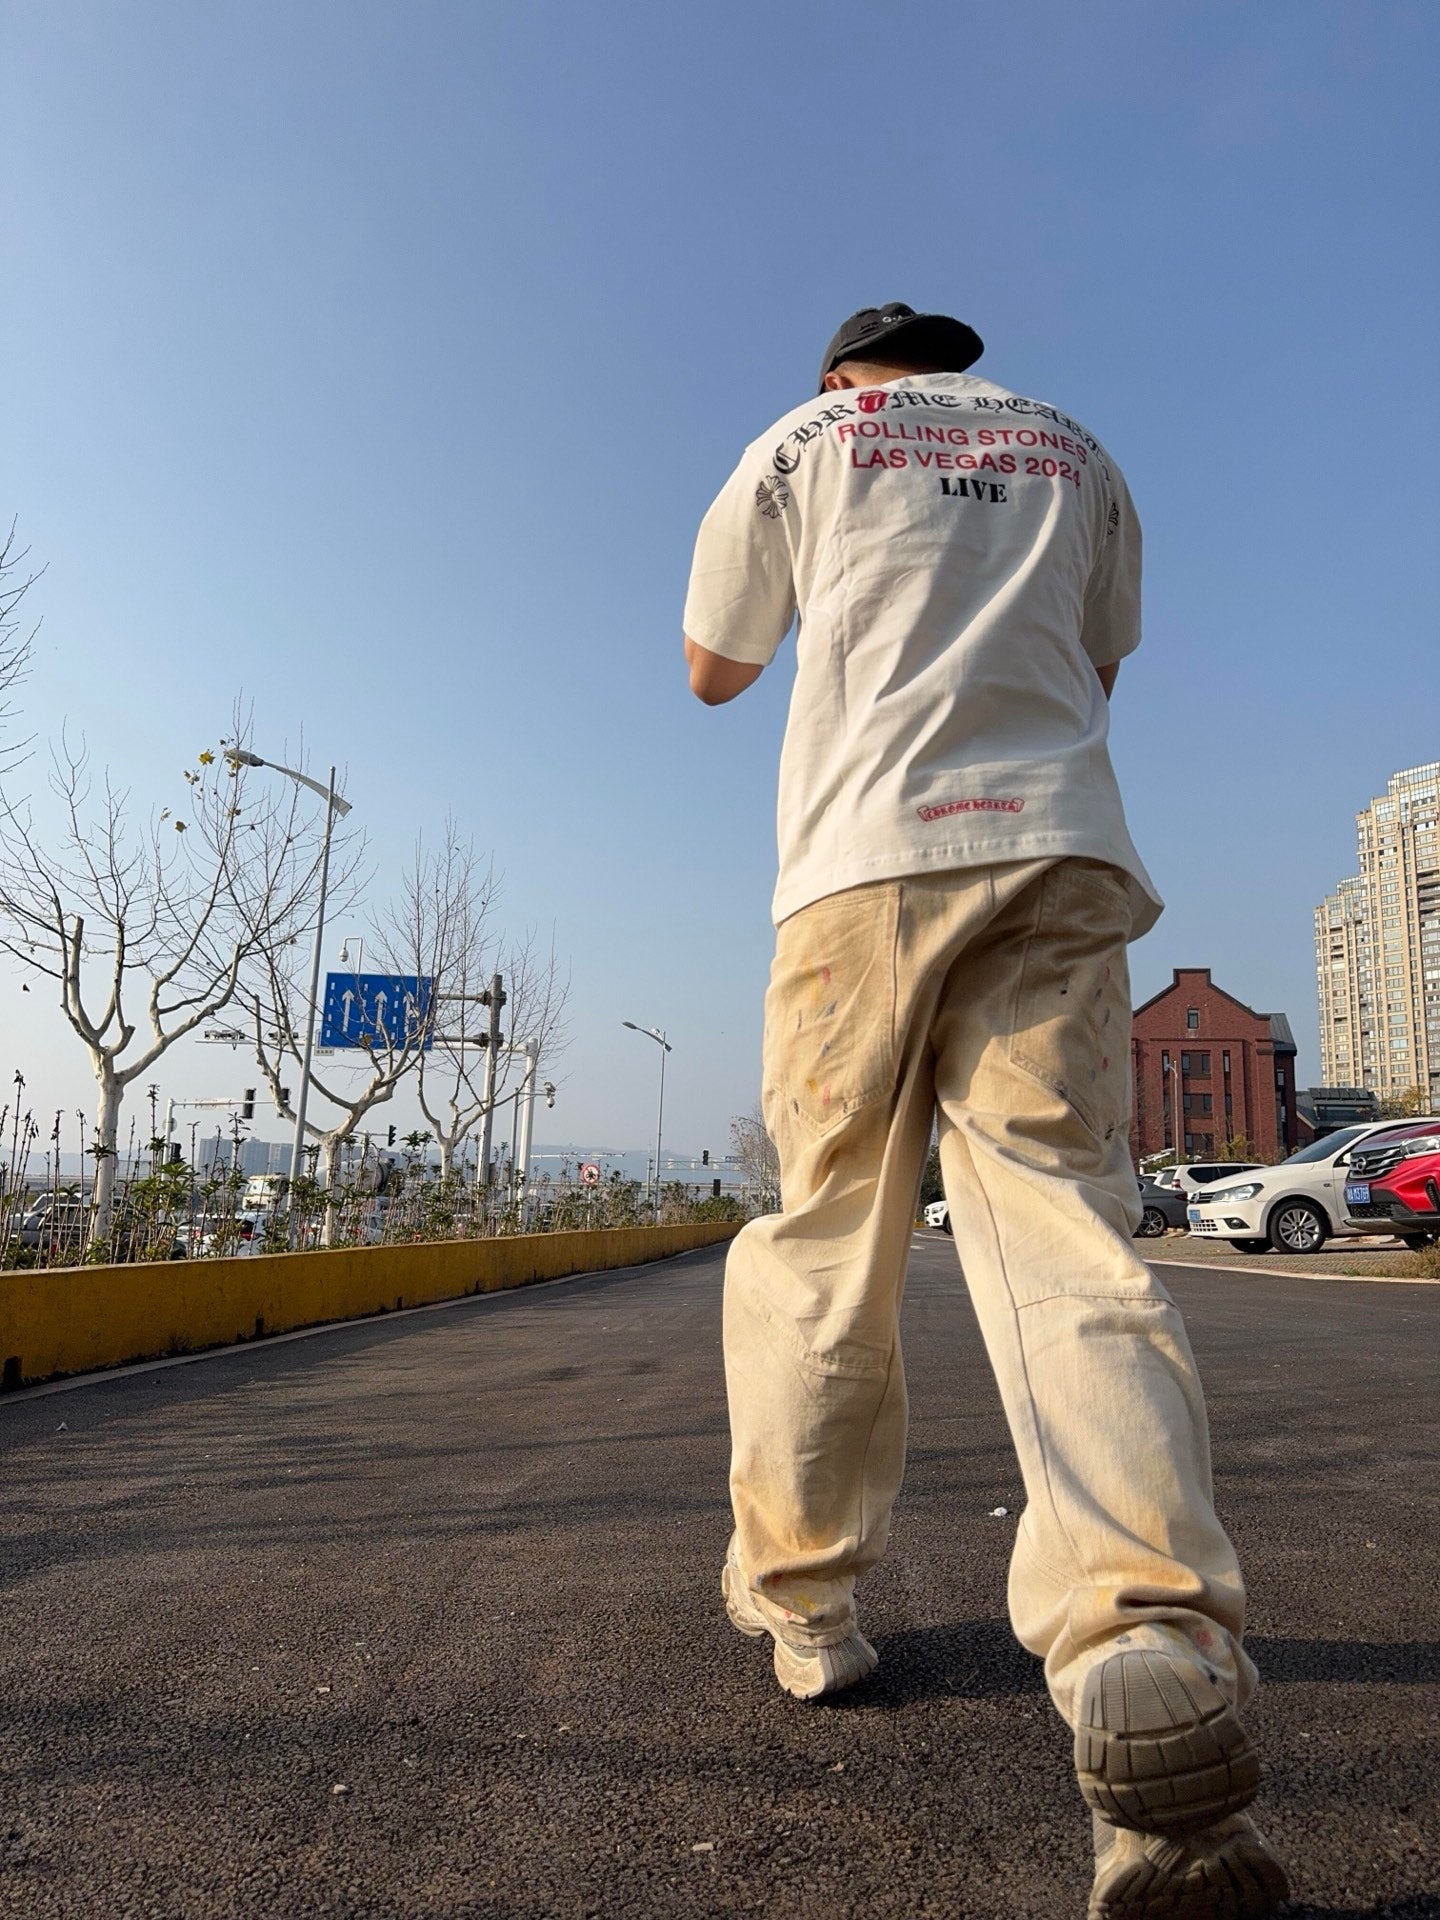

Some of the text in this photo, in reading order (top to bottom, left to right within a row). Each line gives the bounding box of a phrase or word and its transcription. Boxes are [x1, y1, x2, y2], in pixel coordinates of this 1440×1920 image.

[837, 421, 1088, 465] ROLLING STONES
[851, 448, 1081, 489] LAS VEGAS 2024
[940, 477, 1008, 503] LIVE
